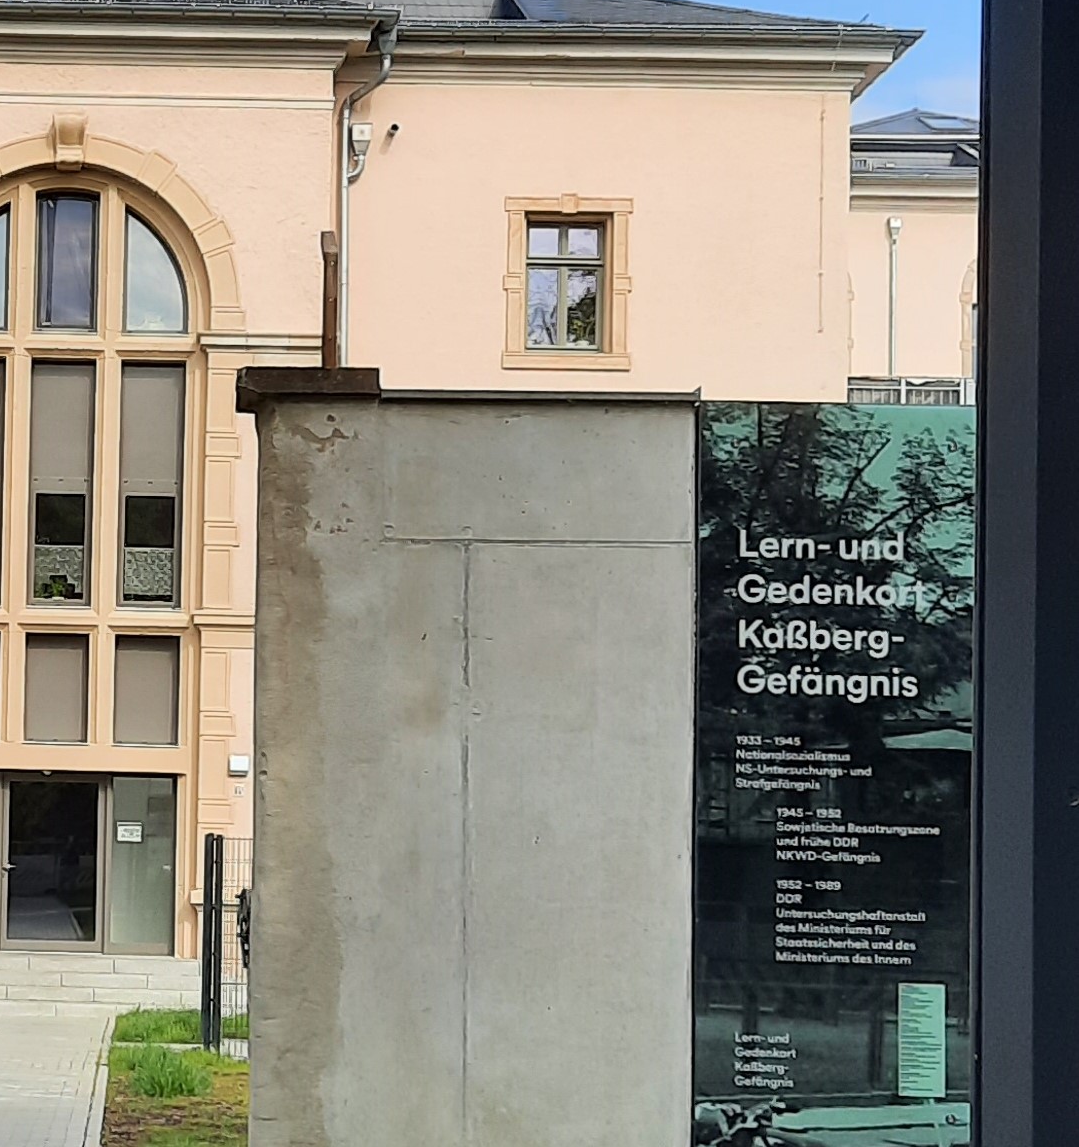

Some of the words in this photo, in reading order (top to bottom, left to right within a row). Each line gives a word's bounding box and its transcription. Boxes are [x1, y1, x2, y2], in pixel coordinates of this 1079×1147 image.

[739, 529, 832, 559] Lern-
[838, 531, 905, 562] und
[737, 574, 926, 609] Gedenkort
[738, 619, 905, 659] Kaßberg-
[737, 664, 919, 703] Gefängnis
[736, 735, 762, 745] 1933
[773, 736, 802, 746] 1945
[735, 748, 851, 761] Nationalsozialismus
[735, 763, 848, 778] NS-Untersuchungs-
[850, 765, 873, 777] und
[735, 777, 821, 791] Strafgefängnis
[776, 807, 804, 818] 1945
[815, 808, 842, 819] 1952
[776, 821, 846, 834] Sowjetische
[776, 836, 799, 847] und
[800, 836, 831, 847] frühe
[832, 837, 860, 848] DDR
[776, 850, 882, 865] NKWD-Gefängnis
[776, 879, 803, 890] 1952
[815, 880, 842, 891] 1989
[775, 893, 803, 904] DDR
[775, 907, 926, 923] Untersuchungshaftanstalt
[775, 923, 796, 933] des
[798, 923, 872, 935] Ministeriums
[874, 924, 892, 935] für
[775, 936, 870, 950] Staatssicherheit
[872, 940, 894, 950] und
[895, 940, 917, 951] des
[775, 951, 850, 963] Ministeriums
[852, 953, 872, 964] des
[874, 953, 912, 965] Innern
[767, 1033, 790, 1044] und
